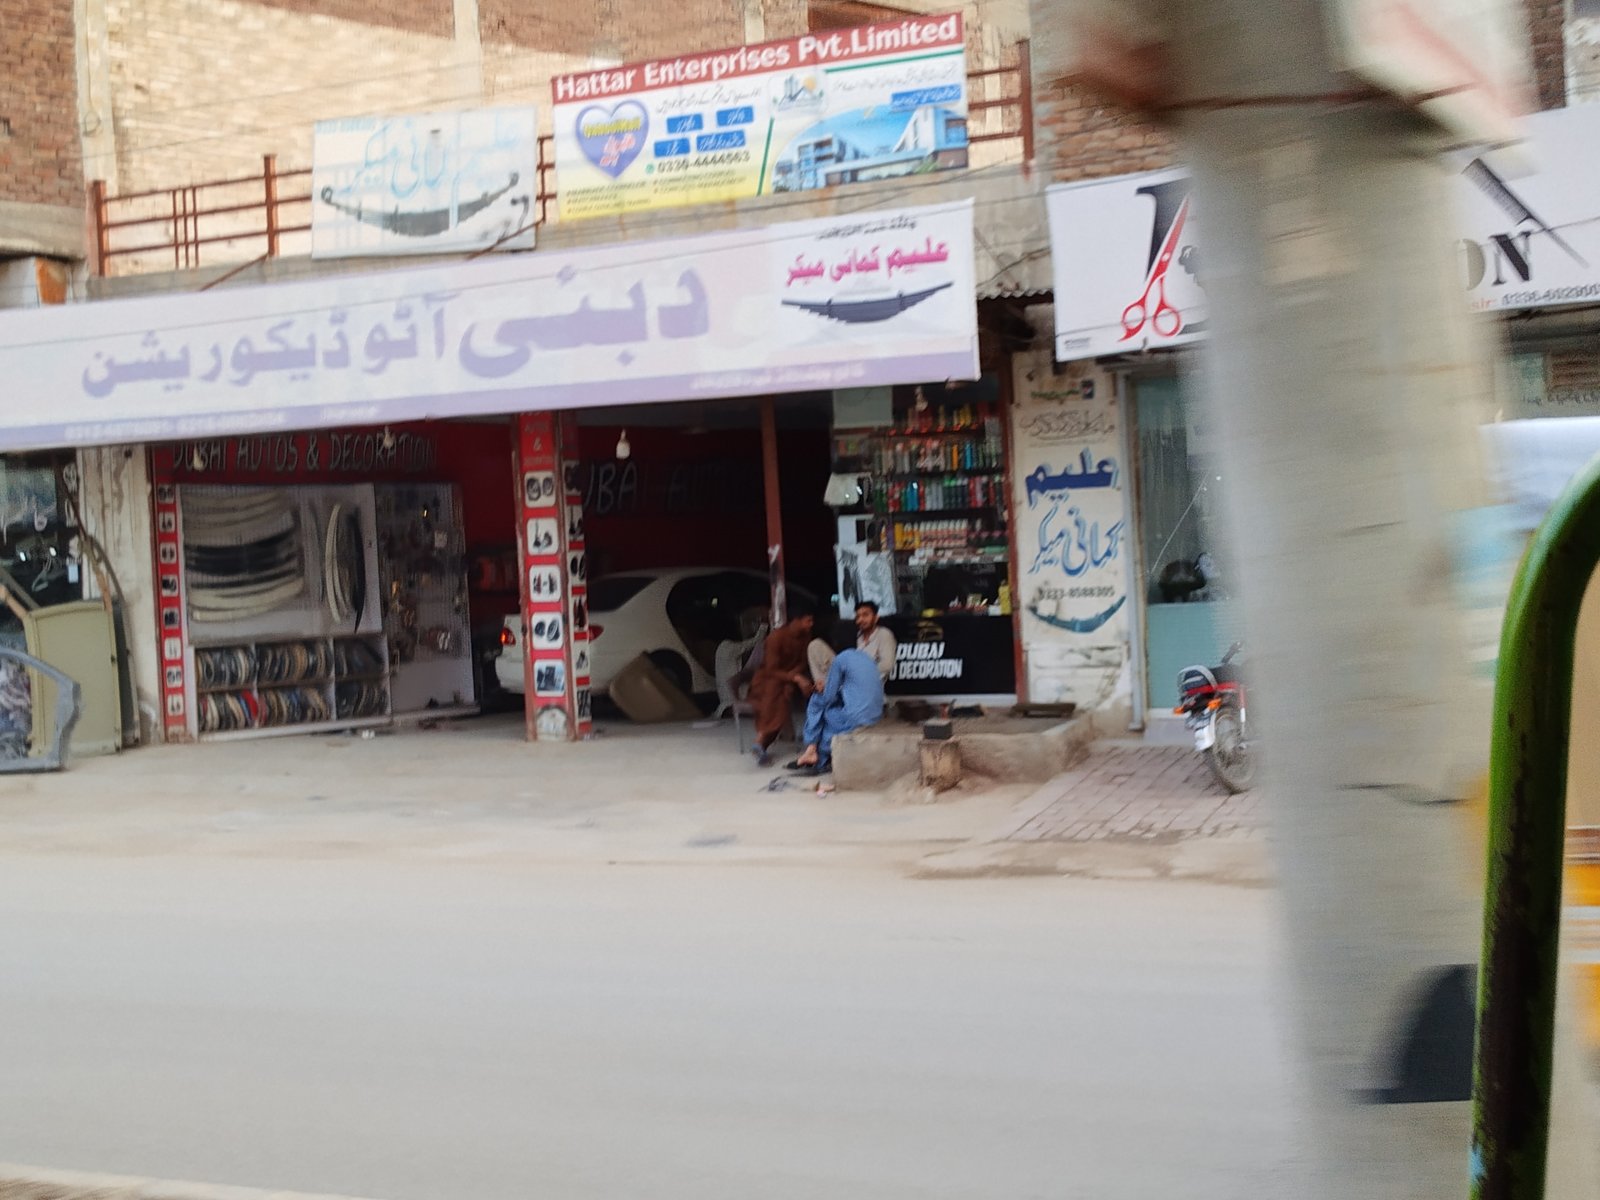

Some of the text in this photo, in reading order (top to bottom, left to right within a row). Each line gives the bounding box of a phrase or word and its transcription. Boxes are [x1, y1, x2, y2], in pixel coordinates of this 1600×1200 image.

[556, 69, 636, 100] Hattar
[644, 44, 791, 87] Enterprises
[236, 436, 299, 472] AUTOS
[305, 434, 320, 471] &
[1025, 447, 1119, 511] علیم
[896, 642, 945, 660] DUBAI
[899, 658, 963, 680] DECORATION
